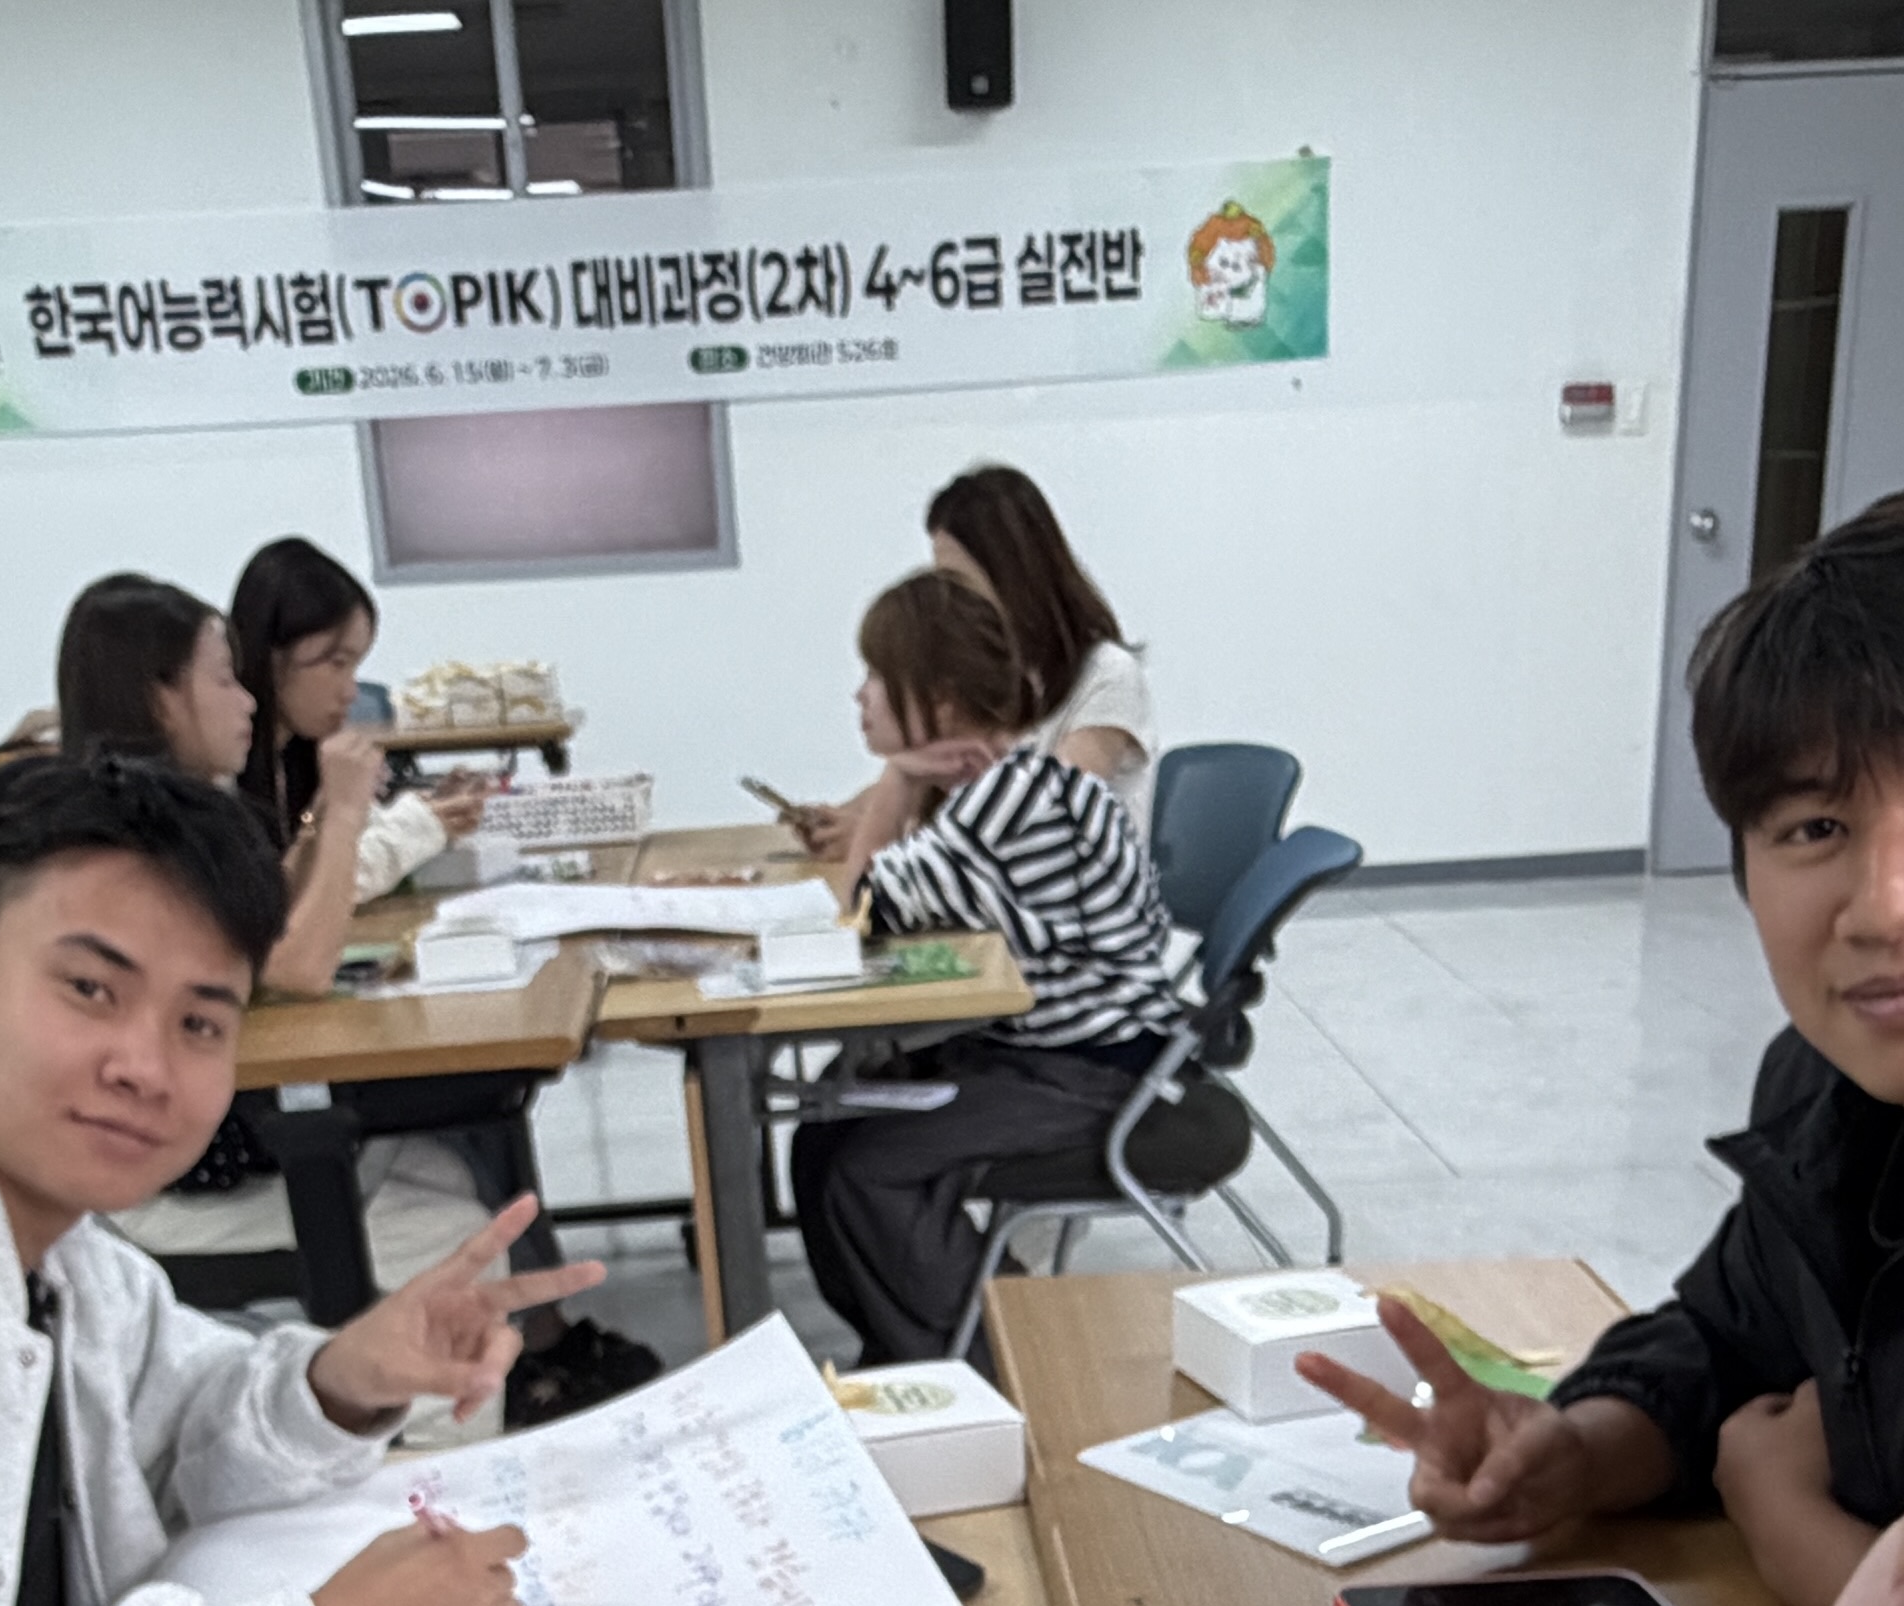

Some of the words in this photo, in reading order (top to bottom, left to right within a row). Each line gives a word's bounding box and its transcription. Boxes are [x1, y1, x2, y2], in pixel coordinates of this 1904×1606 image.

[24, 265, 562, 358] 한국어능력시험(TOPIK)
[569, 243, 852, 330] 대비과정(2차)
[863, 234, 1003, 312] 4~6급
[1016, 228, 1143, 308] 실전반
